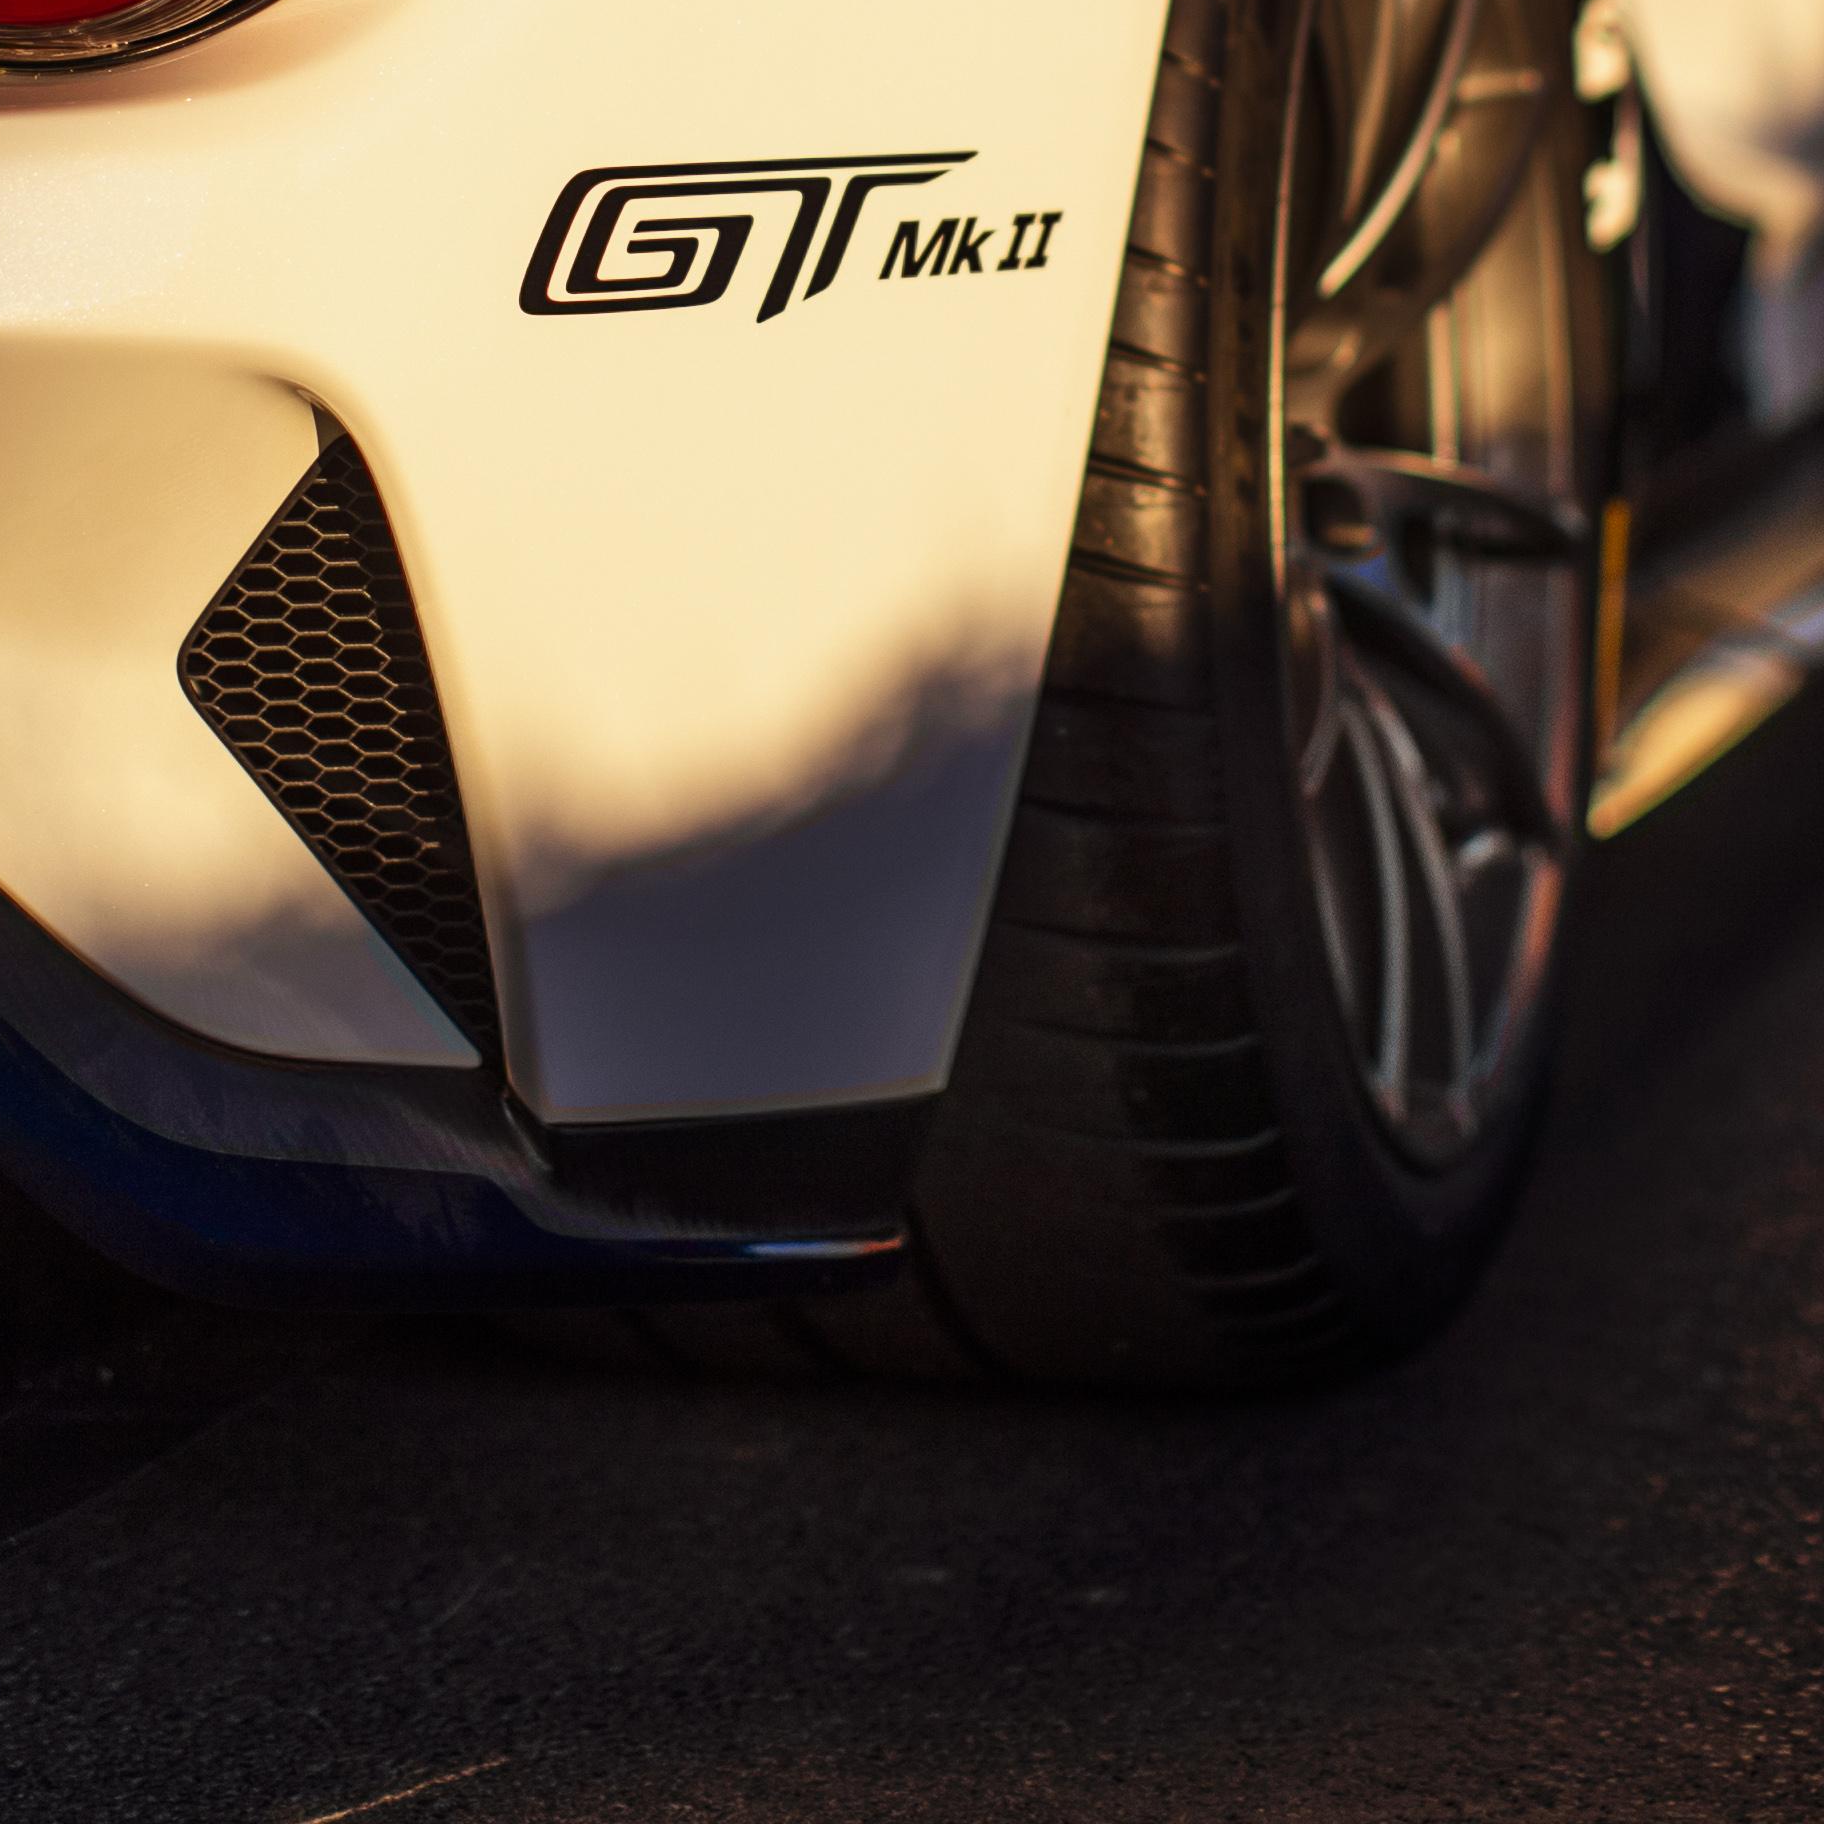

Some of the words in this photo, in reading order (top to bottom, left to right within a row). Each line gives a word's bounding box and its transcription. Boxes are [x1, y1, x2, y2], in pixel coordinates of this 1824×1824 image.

[518, 150, 980, 324] GT
[878, 217, 997, 281] Mk
[996, 210, 1064, 272] II
